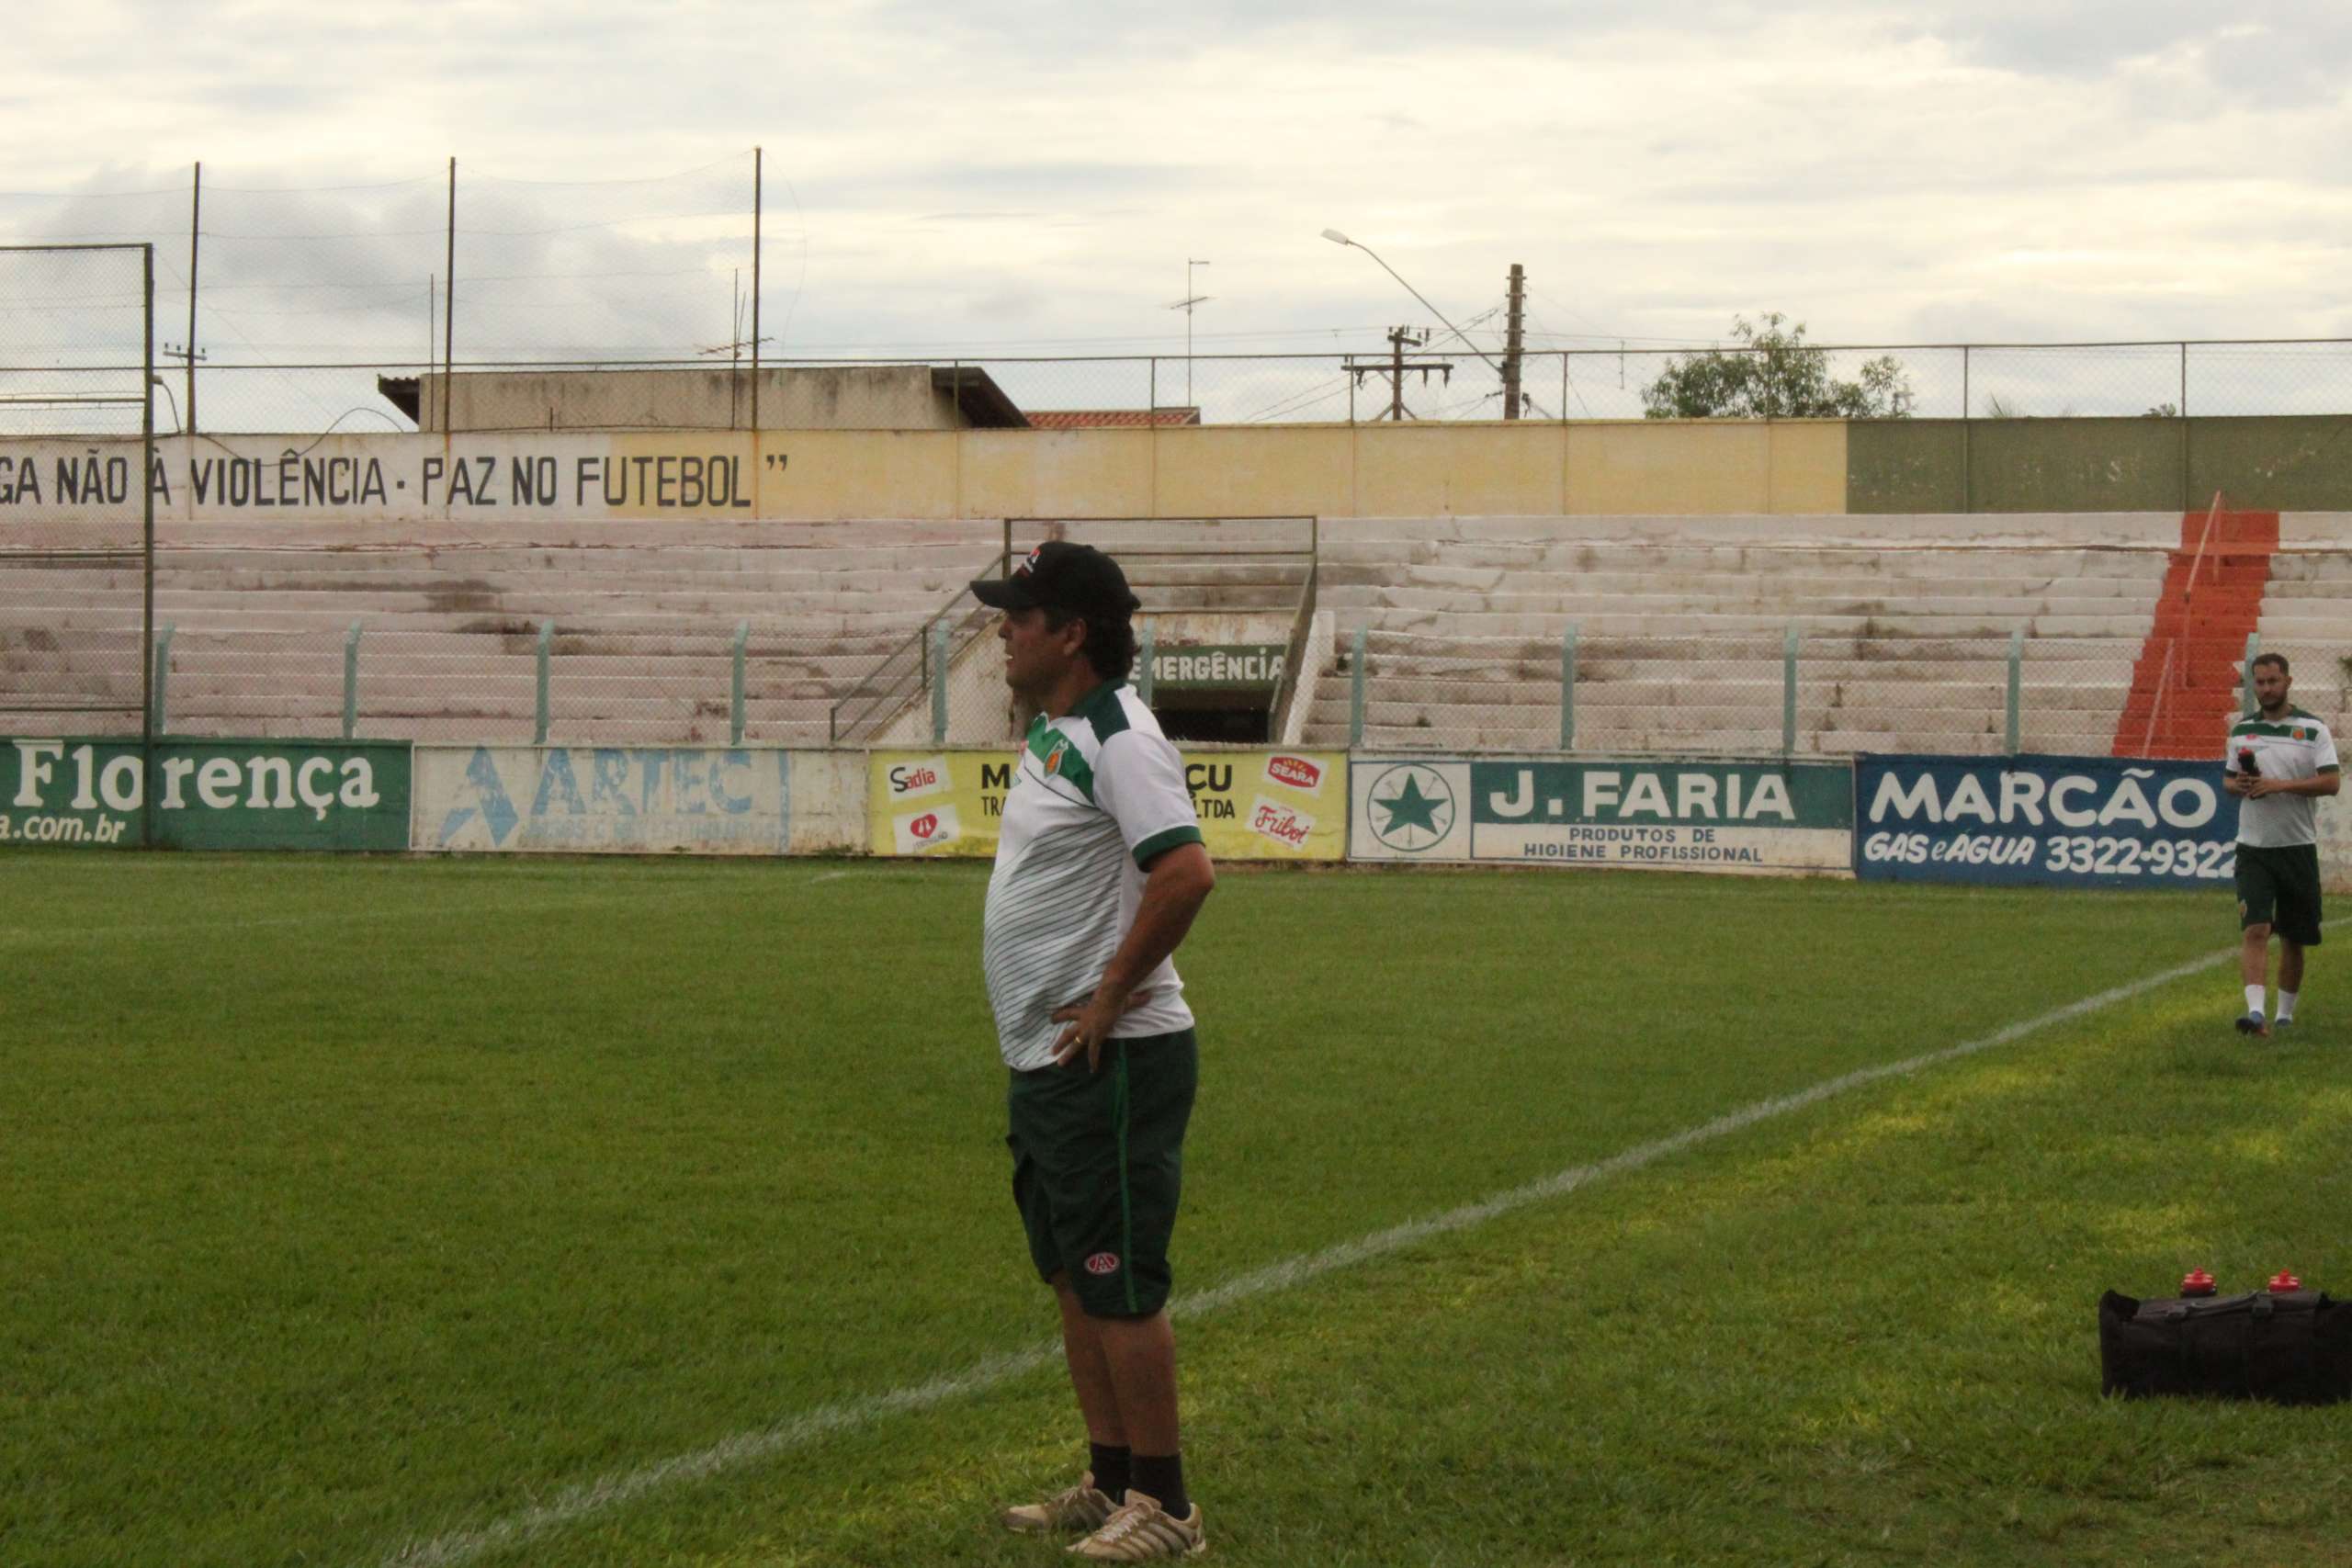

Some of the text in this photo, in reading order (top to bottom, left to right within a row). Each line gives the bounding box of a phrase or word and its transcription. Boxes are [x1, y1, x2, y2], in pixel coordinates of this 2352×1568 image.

[56, 448, 128, 505] NÃO
[190, 447, 388, 507] VIOLÊNCIA
[423, 457, 497, 506] PAZ
[512, 457, 558, 507] NO
[13, 739, 380, 821] Florença
[530, 747, 752, 817] ARTEC
[889, 766, 937, 793] Sadia
[1271, 762, 1317, 786] SEARA
[1489, 770, 1796, 820] J. FARIA
[1868, 767, 2218, 829] MARCÃO
[1255, 805, 1311, 844] Friboi
[1569, 828, 1716, 843] PRODUTOS DE
[1523, 842, 1764, 863] HIGIENE PROFISSIONAL
[2045, 836, 2236, 879] 3322-9322
